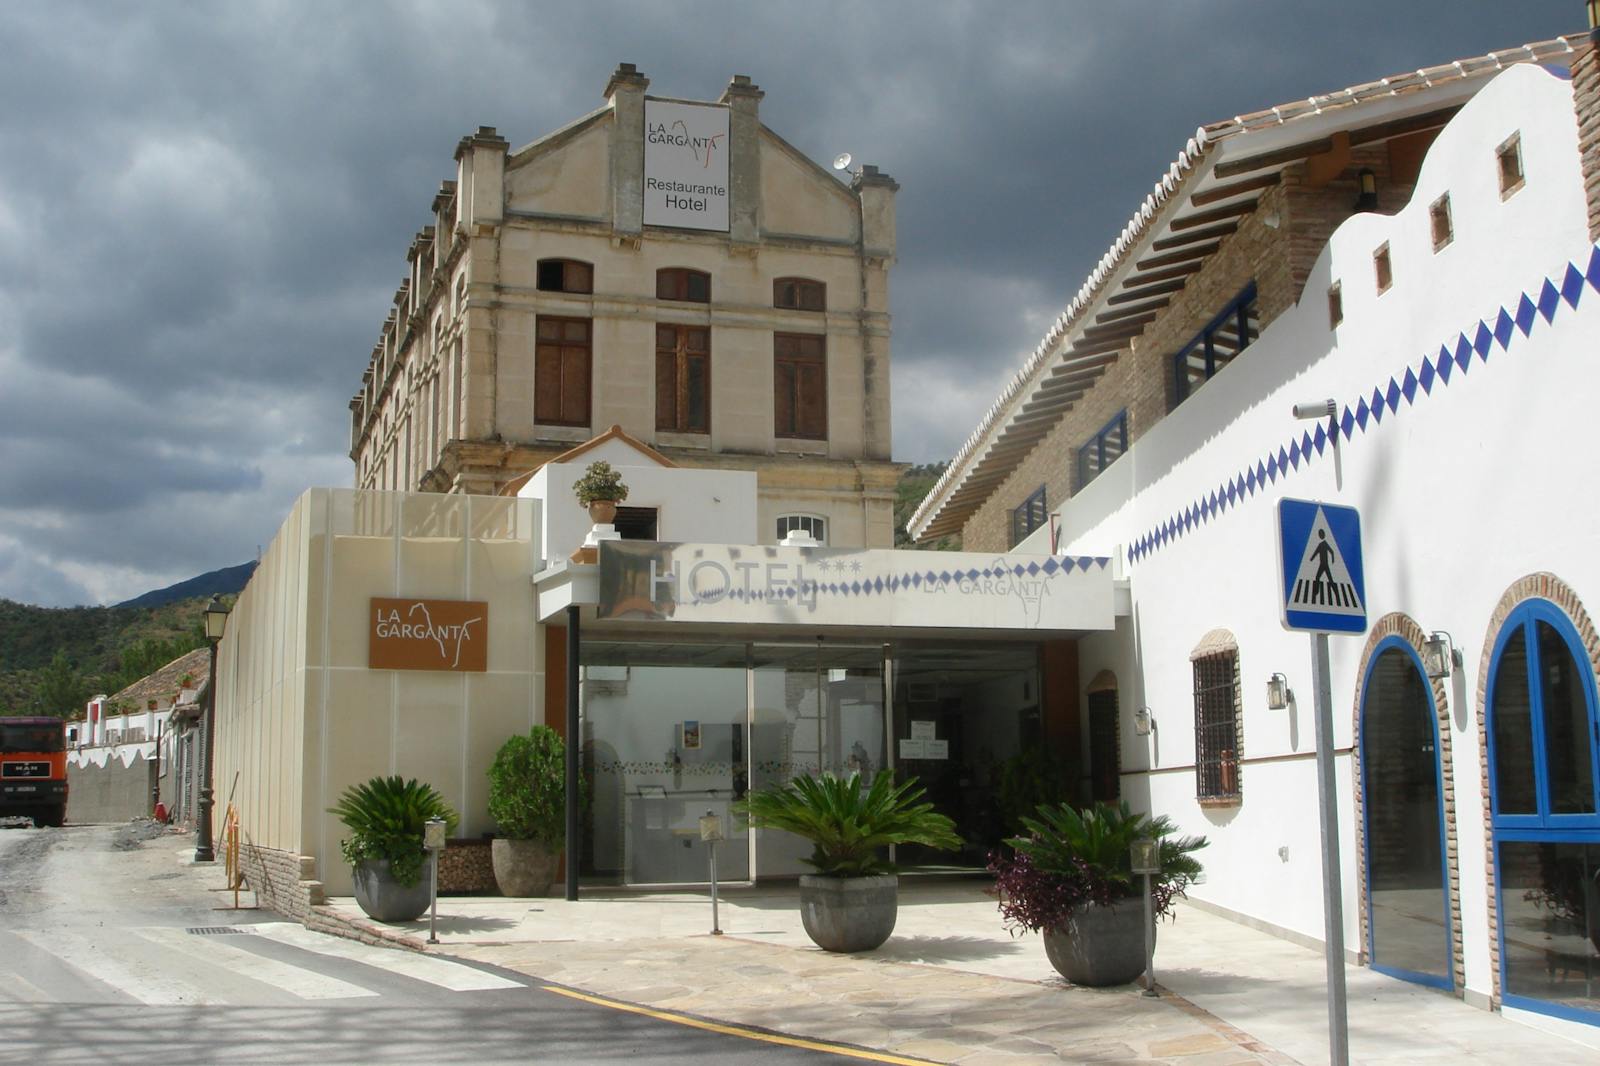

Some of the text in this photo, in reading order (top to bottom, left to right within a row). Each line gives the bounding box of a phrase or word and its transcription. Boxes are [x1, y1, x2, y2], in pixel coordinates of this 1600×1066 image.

[649, 122, 666, 133] LA
[648, 133, 717, 149] GARGANTA
[647, 178, 725, 196] Restaurante
[666, 194, 707, 211] Hotel
[650, 559, 810, 606] HOTEL
[923, 577, 1050, 595] LA GARGANTA
[377, 609, 400, 622] LA
[376, 623, 470, 640] GARGANTA
